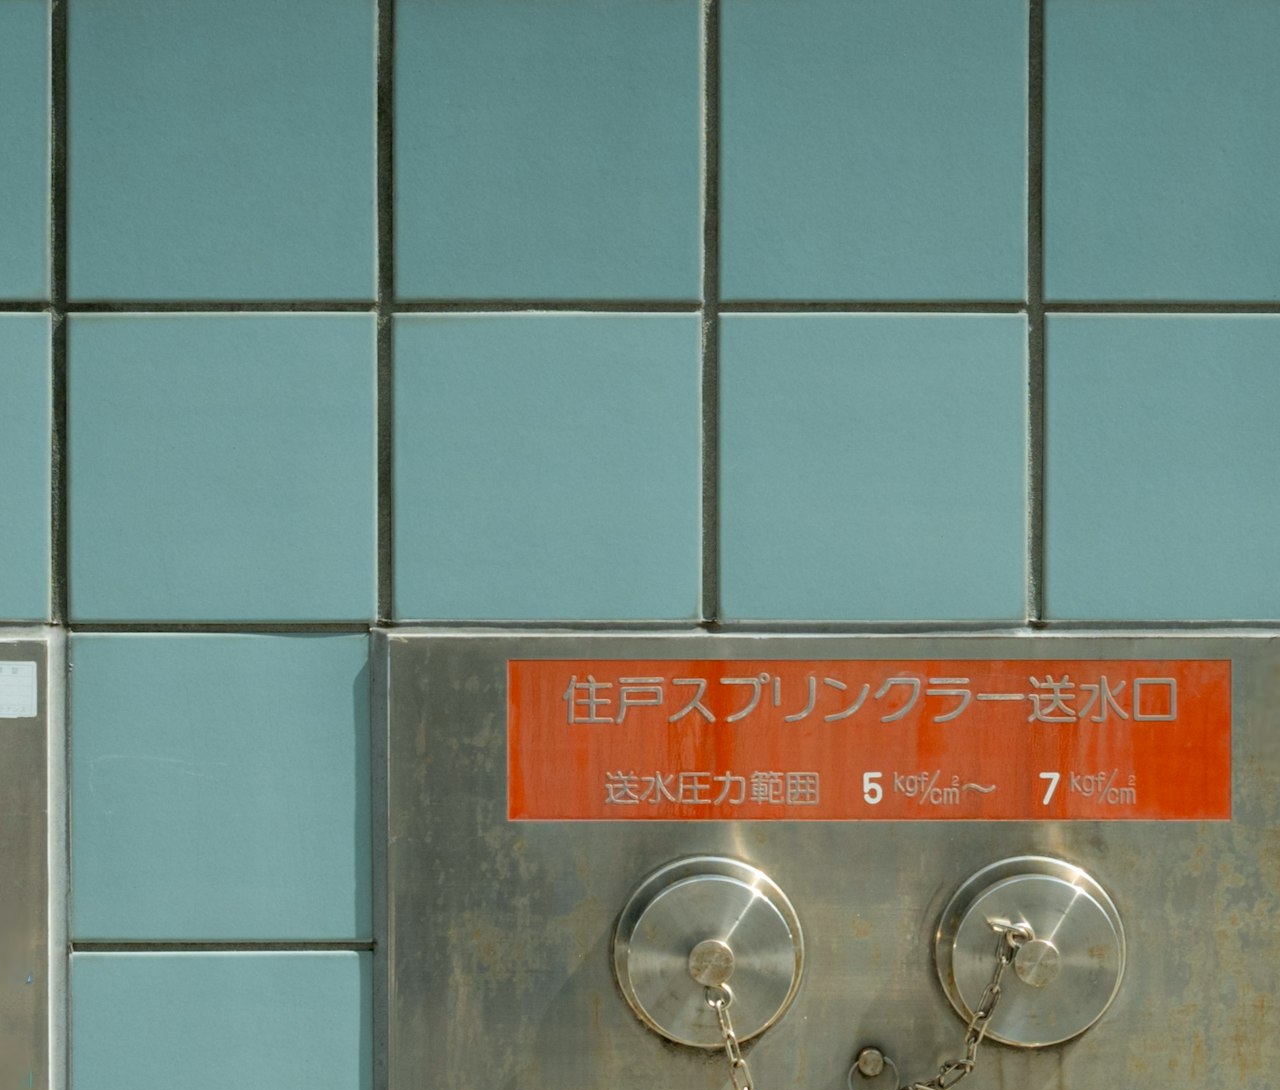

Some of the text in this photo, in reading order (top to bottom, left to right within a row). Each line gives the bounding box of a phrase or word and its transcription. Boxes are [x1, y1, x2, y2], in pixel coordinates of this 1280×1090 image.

[562, 673, 1178, 724] 住戸スプリンクラー送水口
[604, 770, 820, 806] 送水圧力範囲
[862, 772, 883, 804] 5
[1039, 772, 1061, 805] 7
